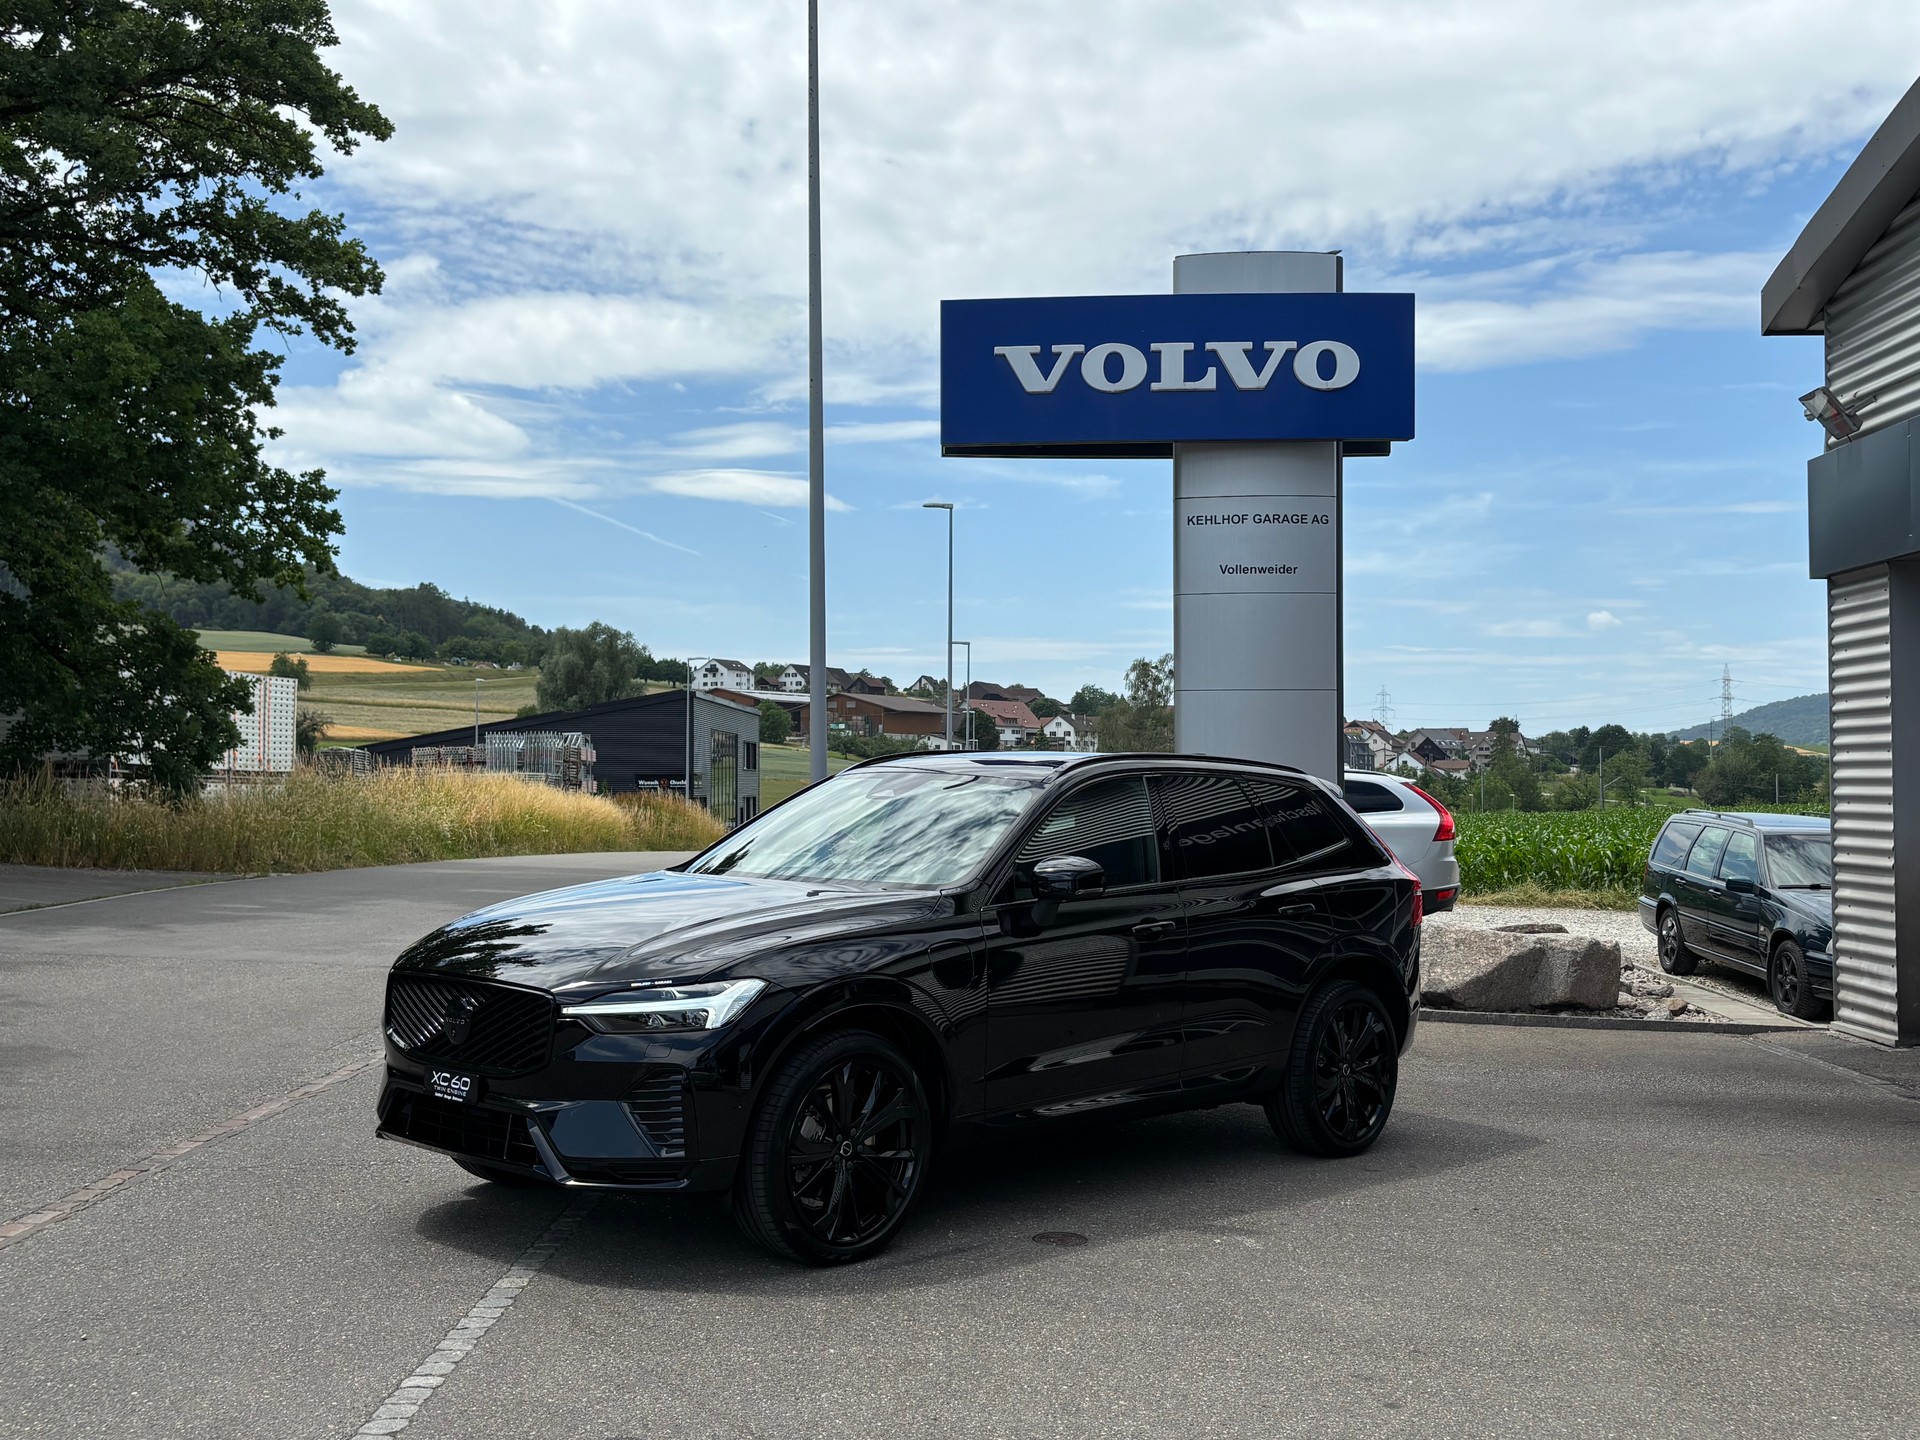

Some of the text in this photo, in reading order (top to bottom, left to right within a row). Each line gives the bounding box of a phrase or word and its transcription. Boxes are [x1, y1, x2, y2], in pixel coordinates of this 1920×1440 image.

[993, 340, 1361, 394] VOLVO
[1186, 513, 1329, 526] KEHLHOF GARAGE AG
[1219, 564, 1299, 575] Vollenweider
